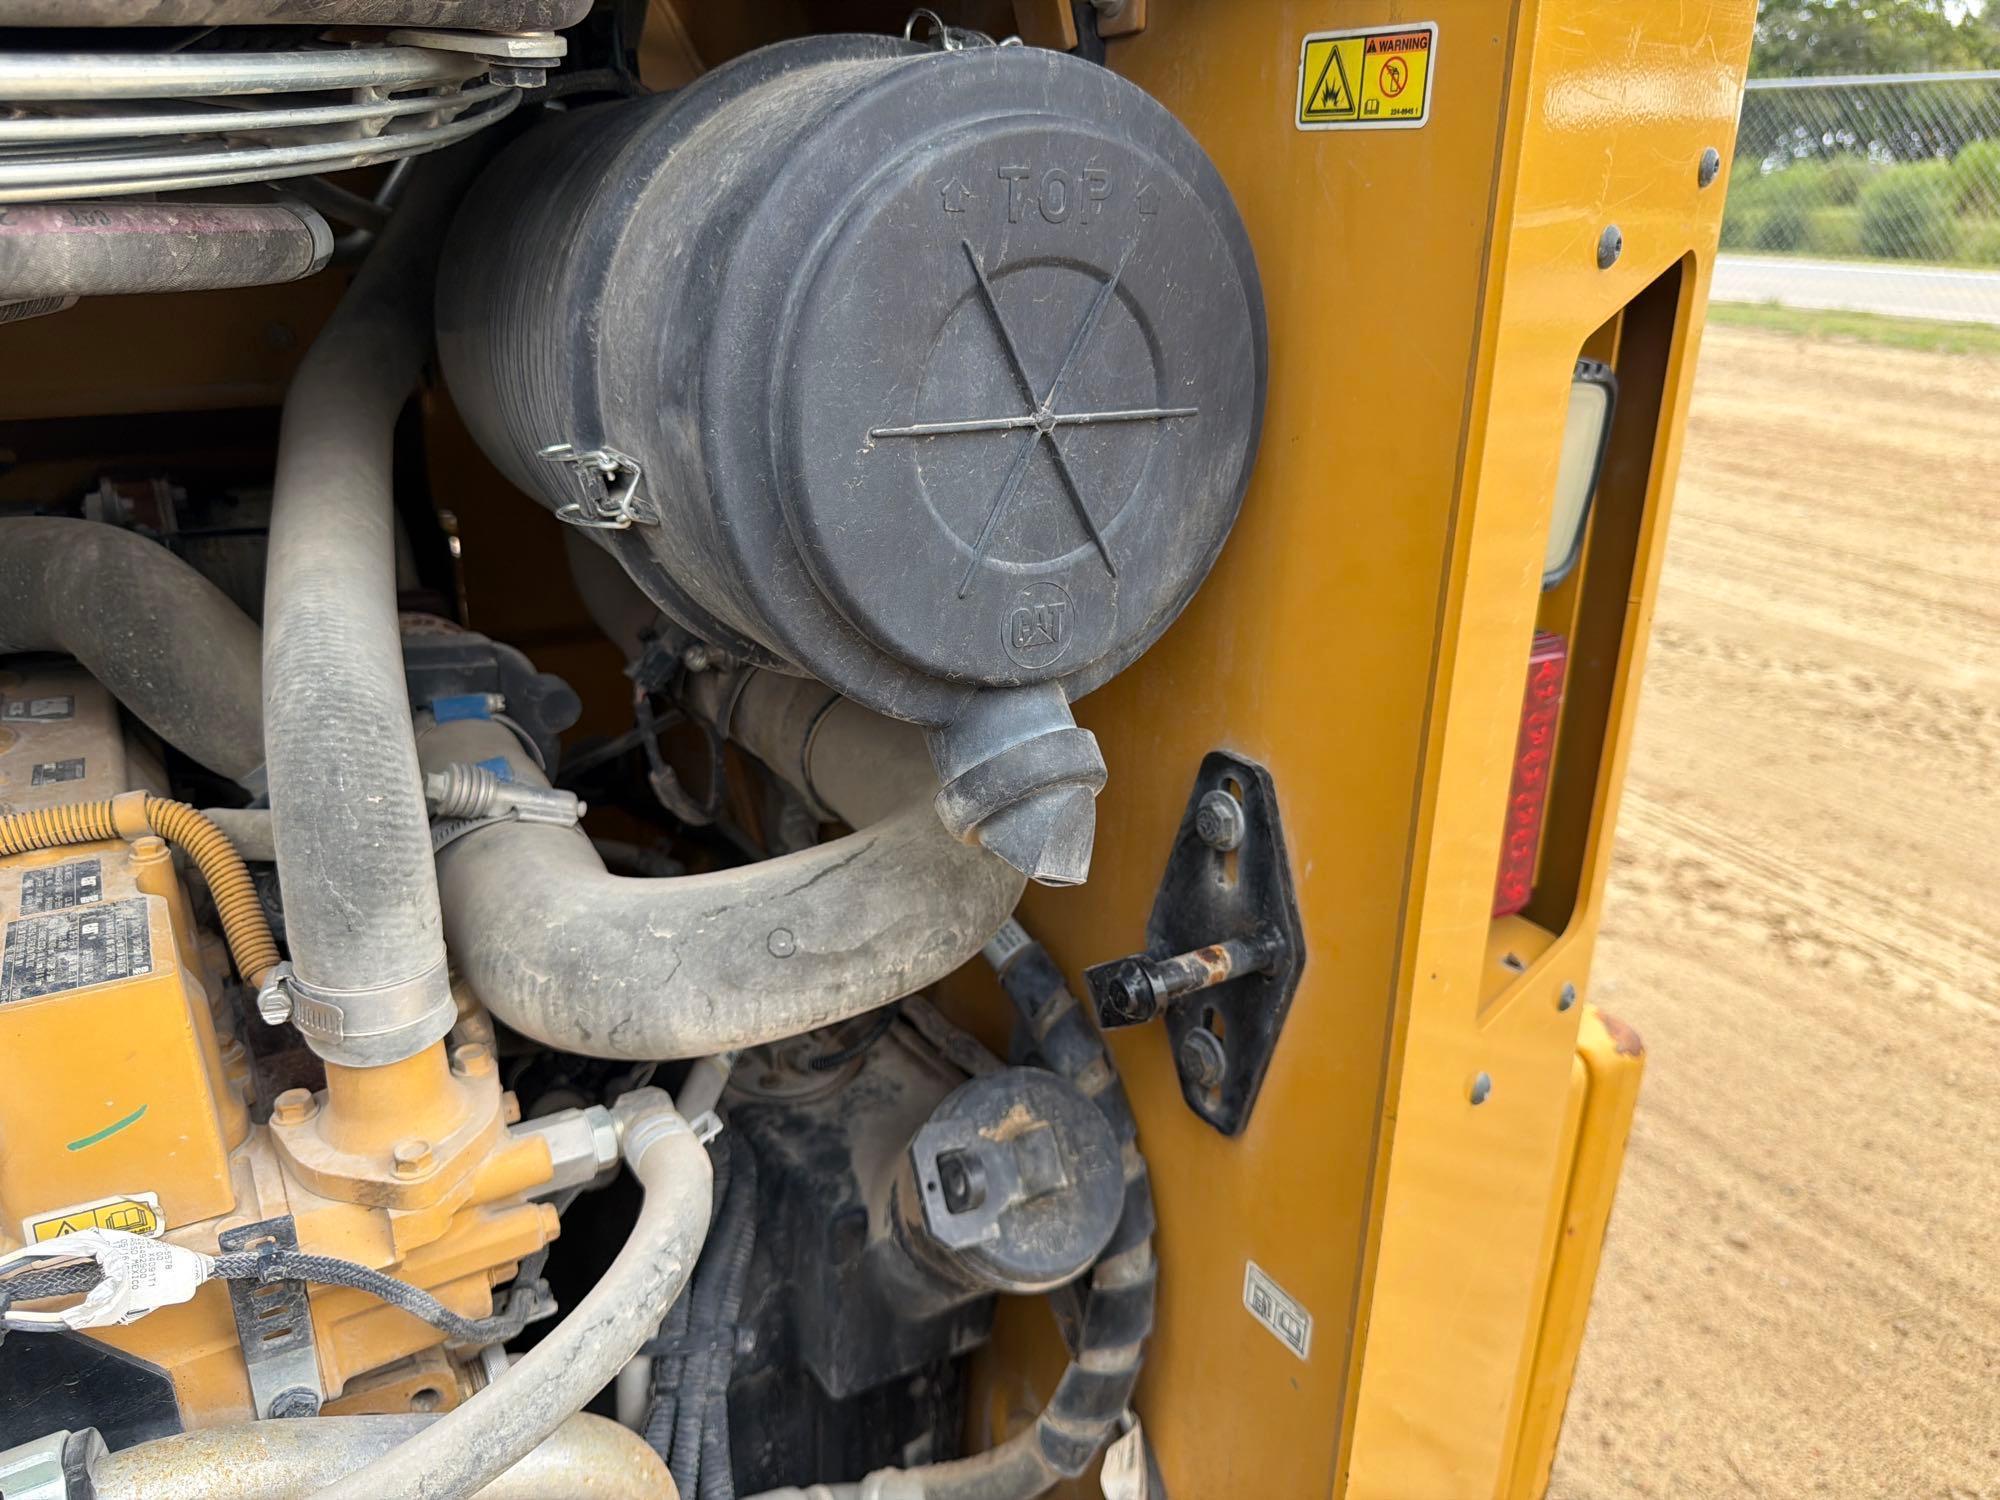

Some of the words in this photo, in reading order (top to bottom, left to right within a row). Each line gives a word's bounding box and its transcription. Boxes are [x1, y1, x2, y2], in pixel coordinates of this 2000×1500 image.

[1379, 37, 1428, 53] WARNING
[998, 165, 1113, 225] TOP
[1009, 601, 1067, 649] CAT
[131, 1259, 139, 1290] MEXICO
